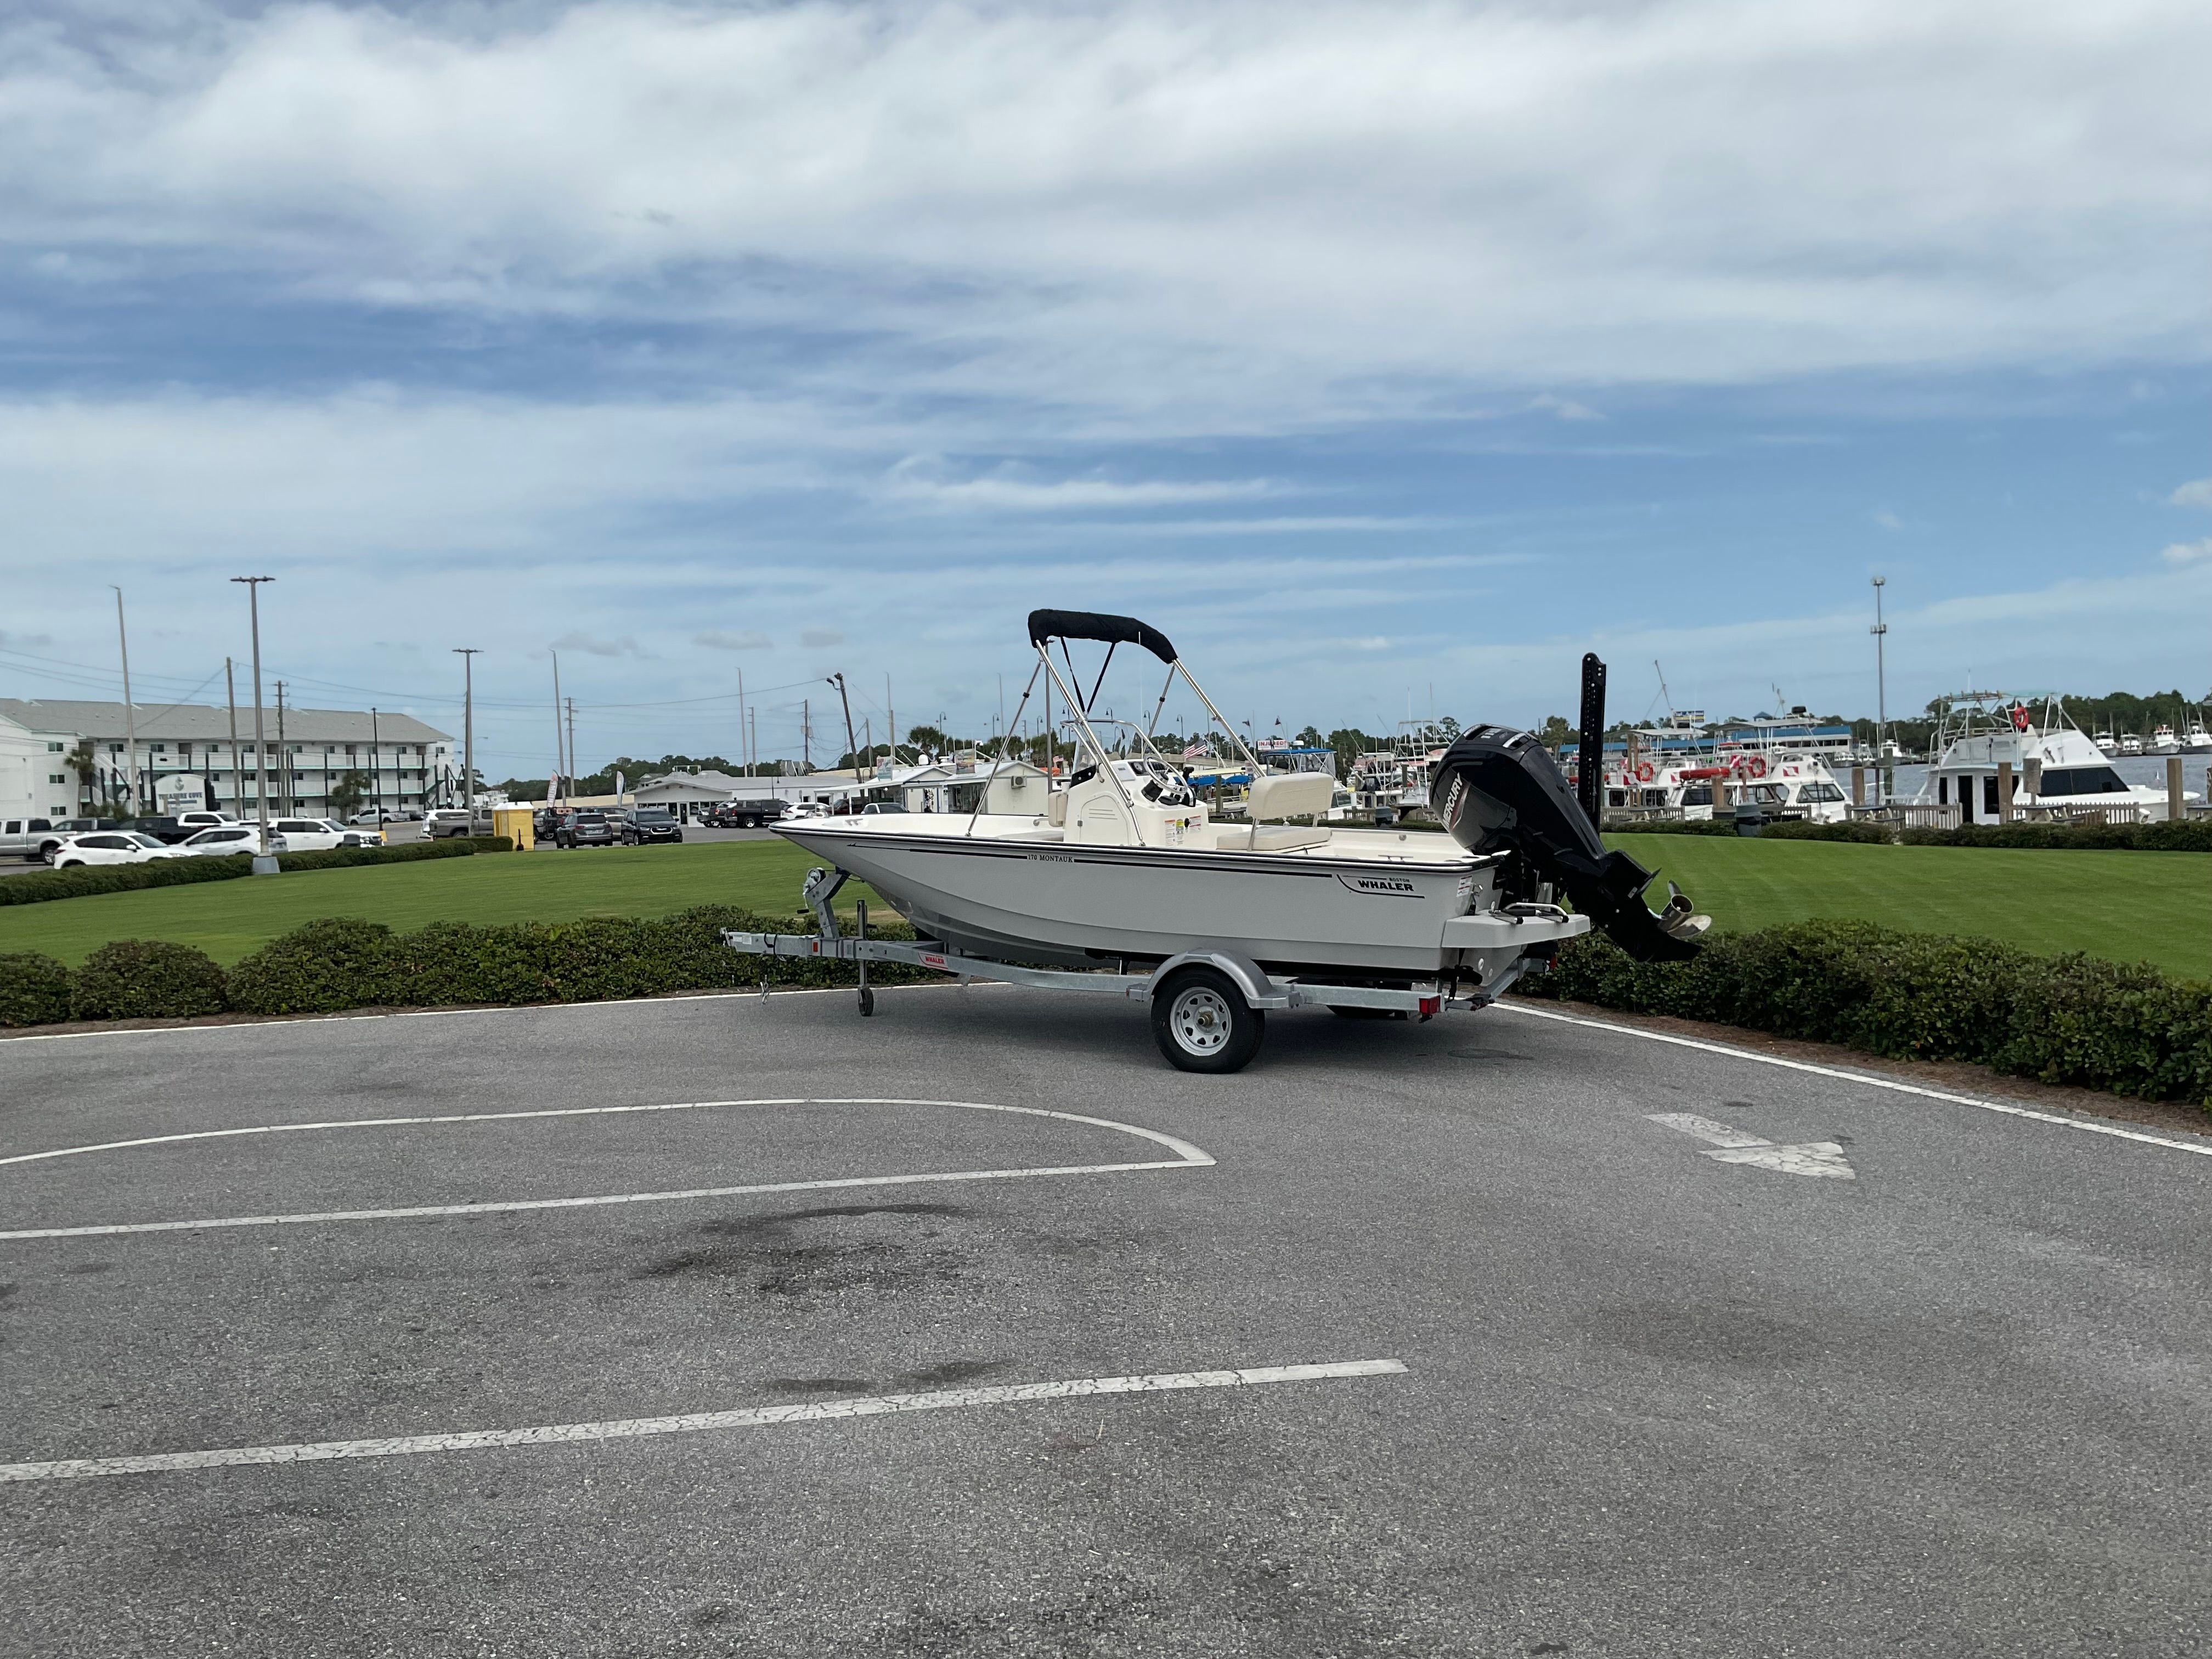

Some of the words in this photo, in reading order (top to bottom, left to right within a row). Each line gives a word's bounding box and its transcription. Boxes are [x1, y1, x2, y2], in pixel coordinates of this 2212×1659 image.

[1443, 772, 1463, 828] MERCURY
[1039, 855, 1073, 863] MONTAUK
[1357, 879, 1414, 891] WHALER
